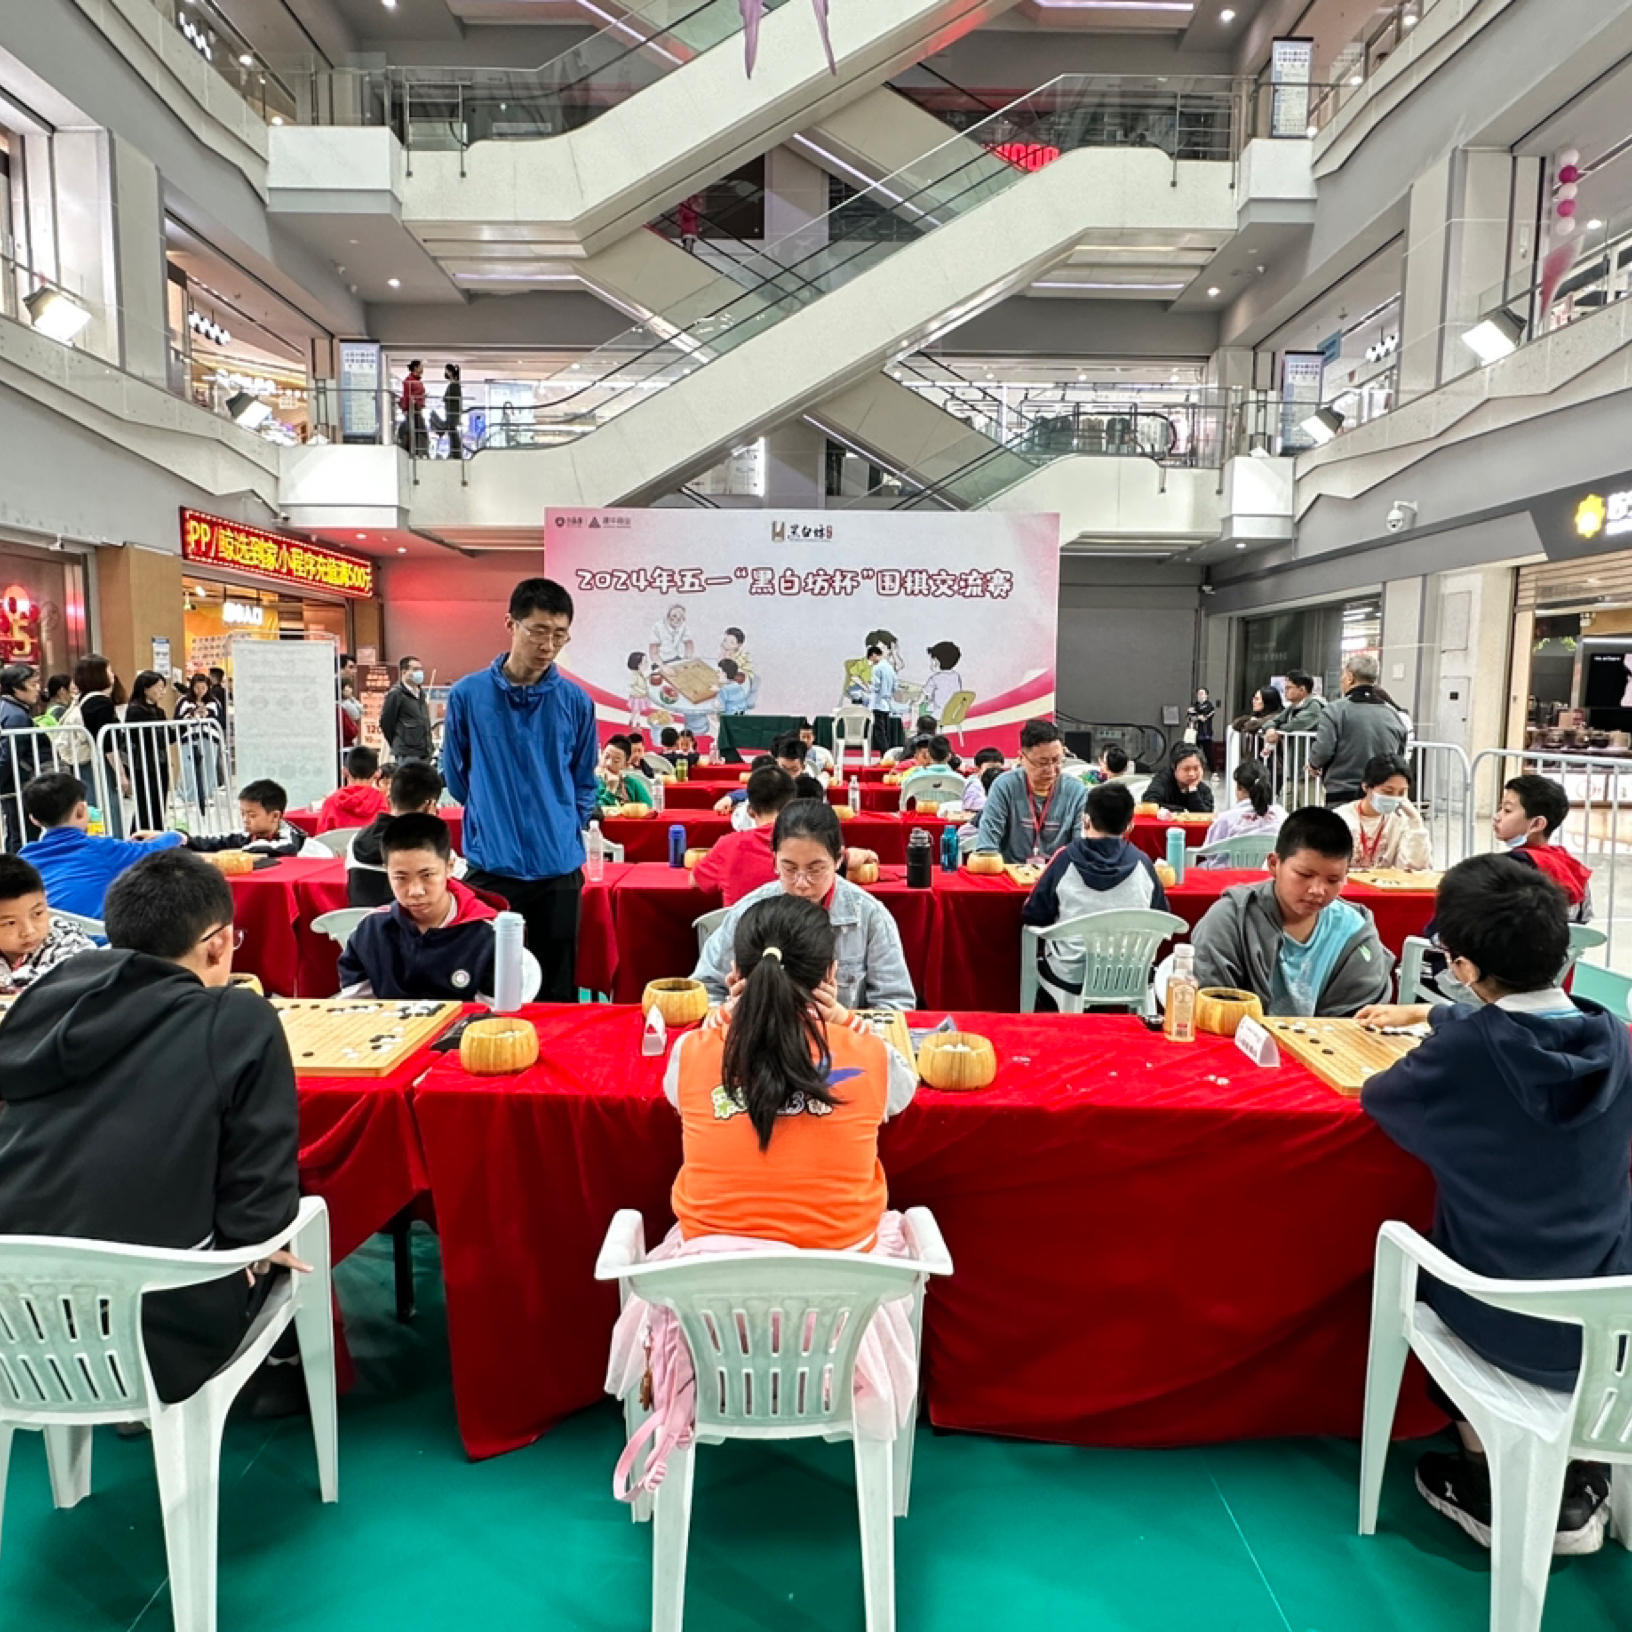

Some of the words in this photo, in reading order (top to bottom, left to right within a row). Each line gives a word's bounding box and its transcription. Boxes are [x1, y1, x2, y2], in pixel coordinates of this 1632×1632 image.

[575, 565, 1014, 599] 2024年五一“黑白坊杯”围棋交流赛
